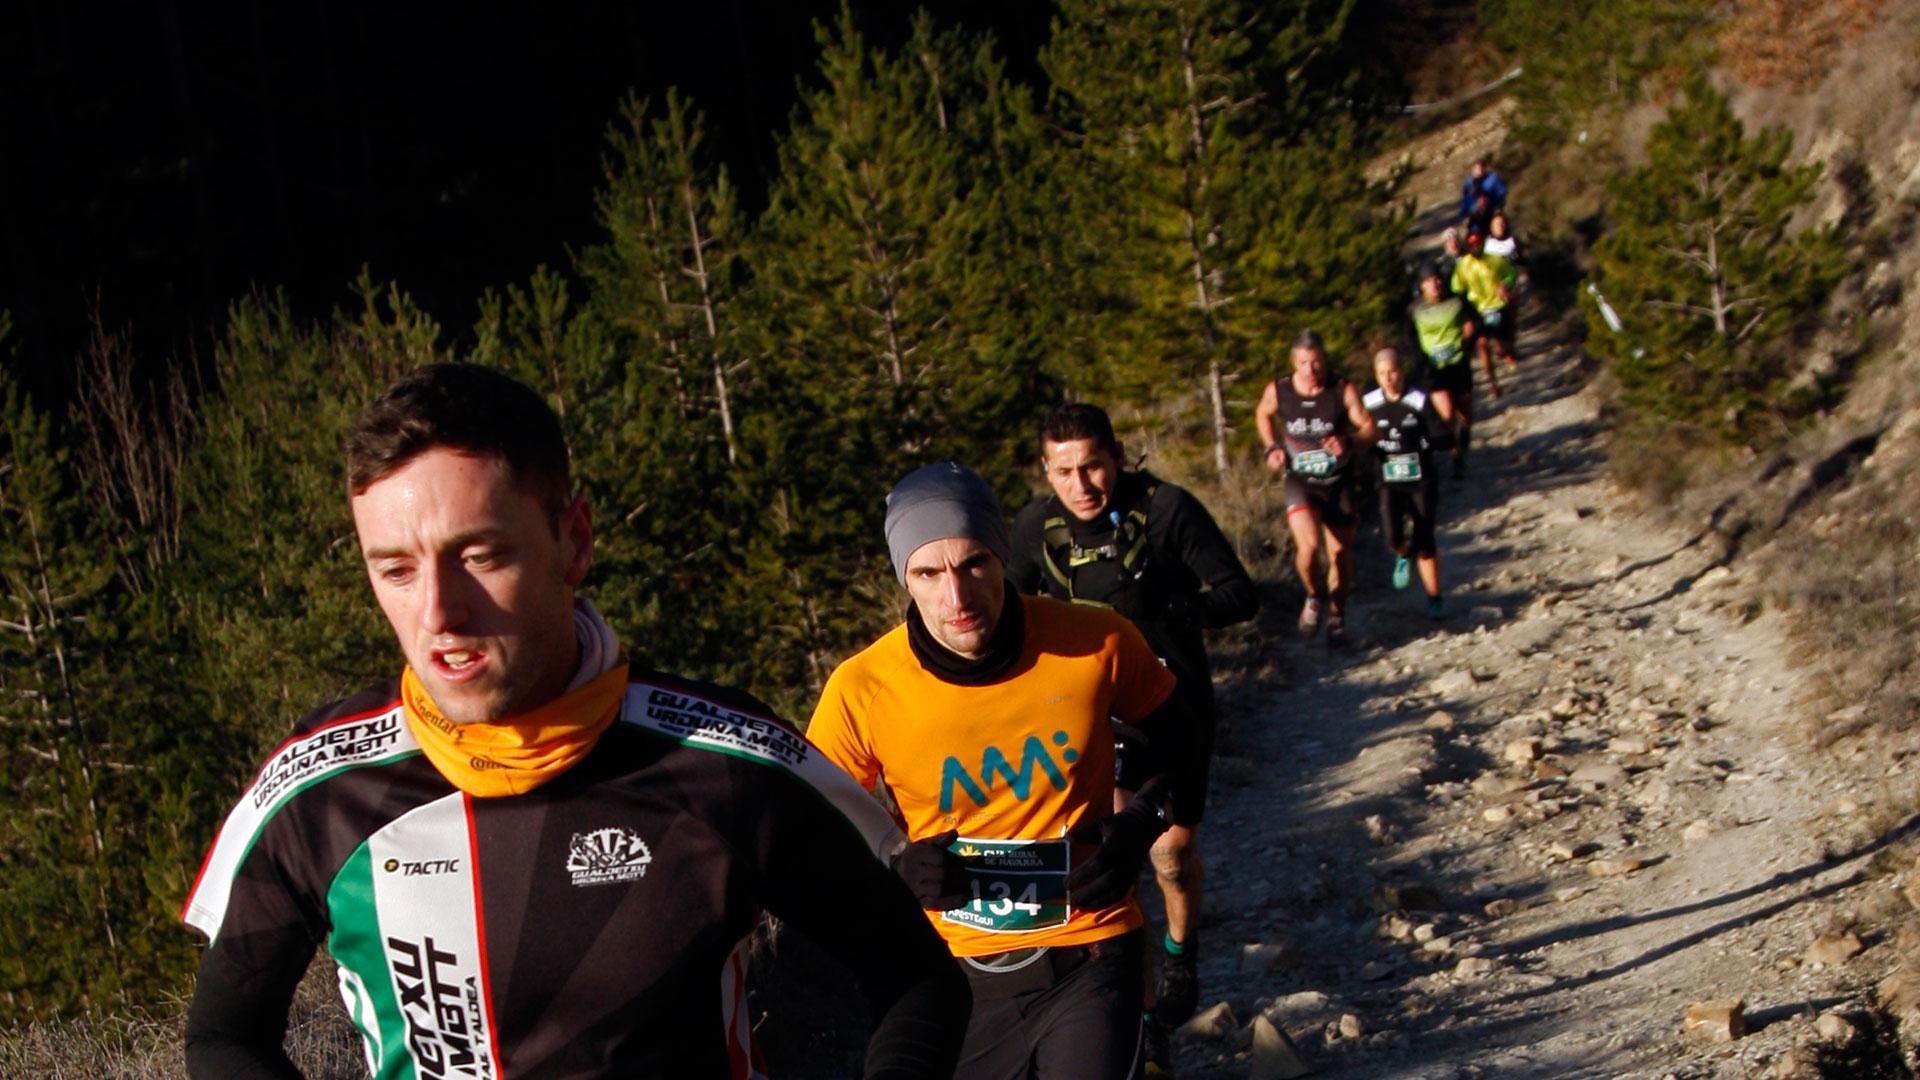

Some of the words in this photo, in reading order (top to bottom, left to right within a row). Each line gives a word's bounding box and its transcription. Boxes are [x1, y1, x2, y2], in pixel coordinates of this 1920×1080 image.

[649, 689, 808, 753] GUALDETXU
[402, 859, 460, 877] TACTIC
[970, 879, 1042, 917] 134
[464, 976, 485, 1046] TALDEA
